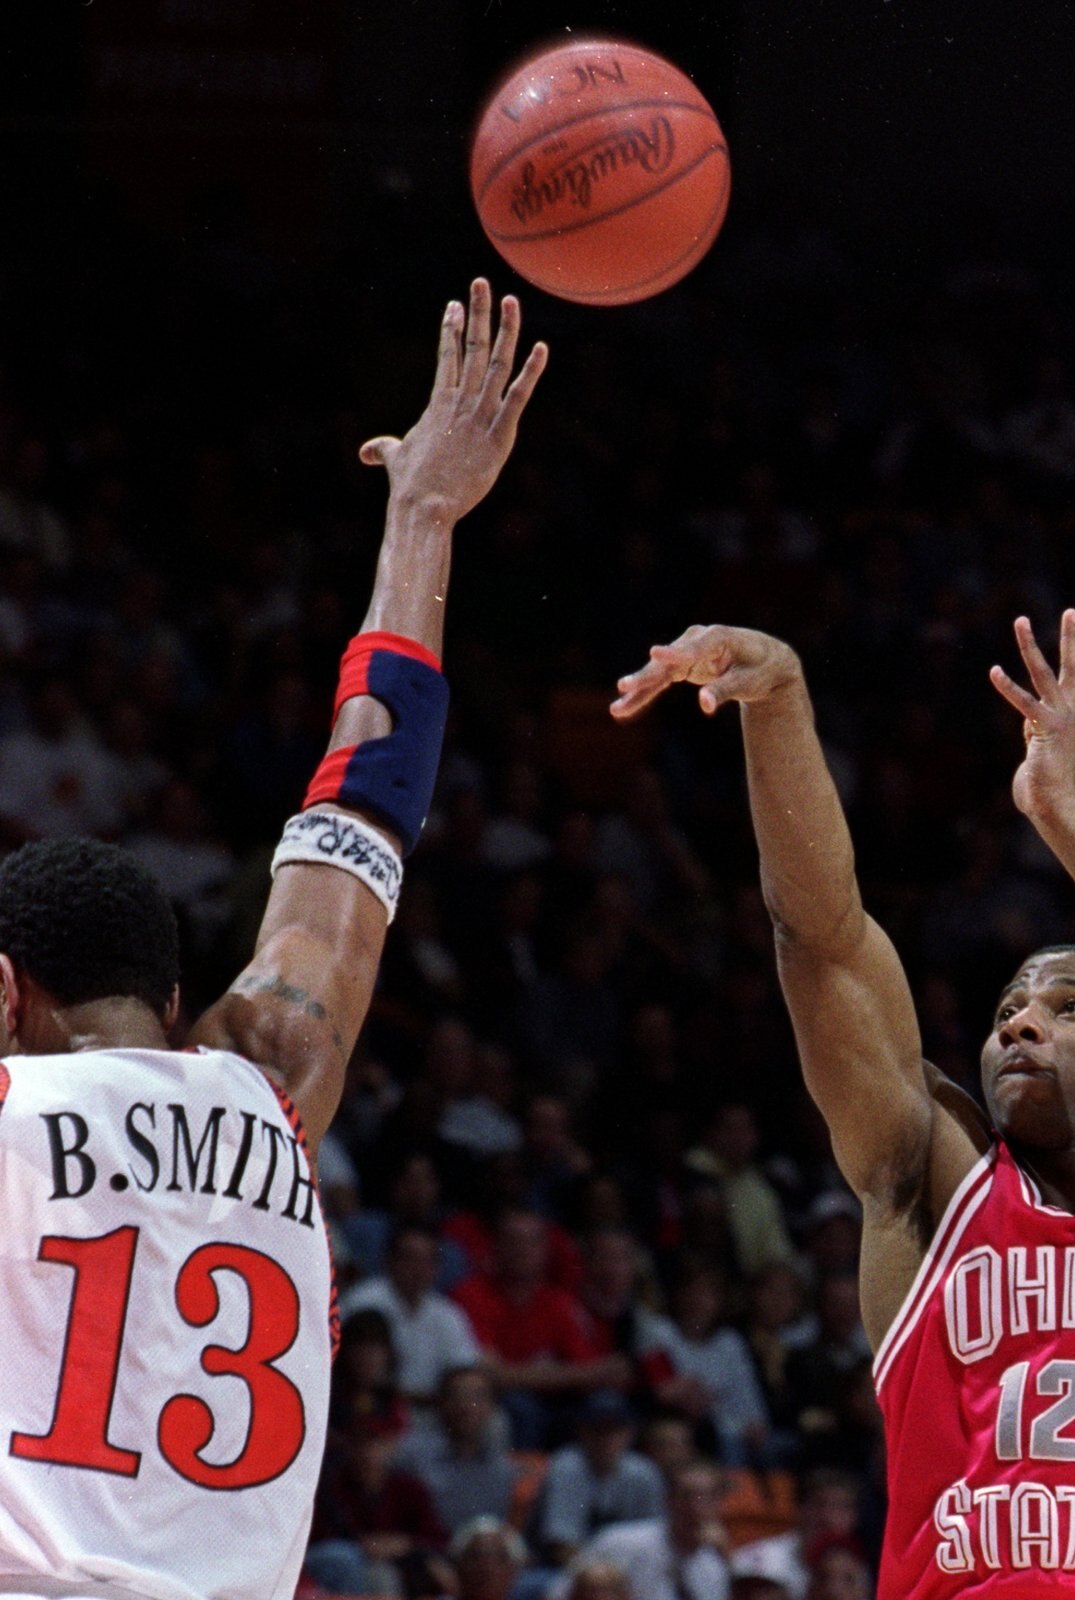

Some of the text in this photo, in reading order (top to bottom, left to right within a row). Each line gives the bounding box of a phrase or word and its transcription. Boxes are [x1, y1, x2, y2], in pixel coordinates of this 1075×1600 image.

[511, 113, 675, 224] Rawlings
[39, 1102, 315, 1229] B.SMITH
[9, 1225, 306, 1491] 13
